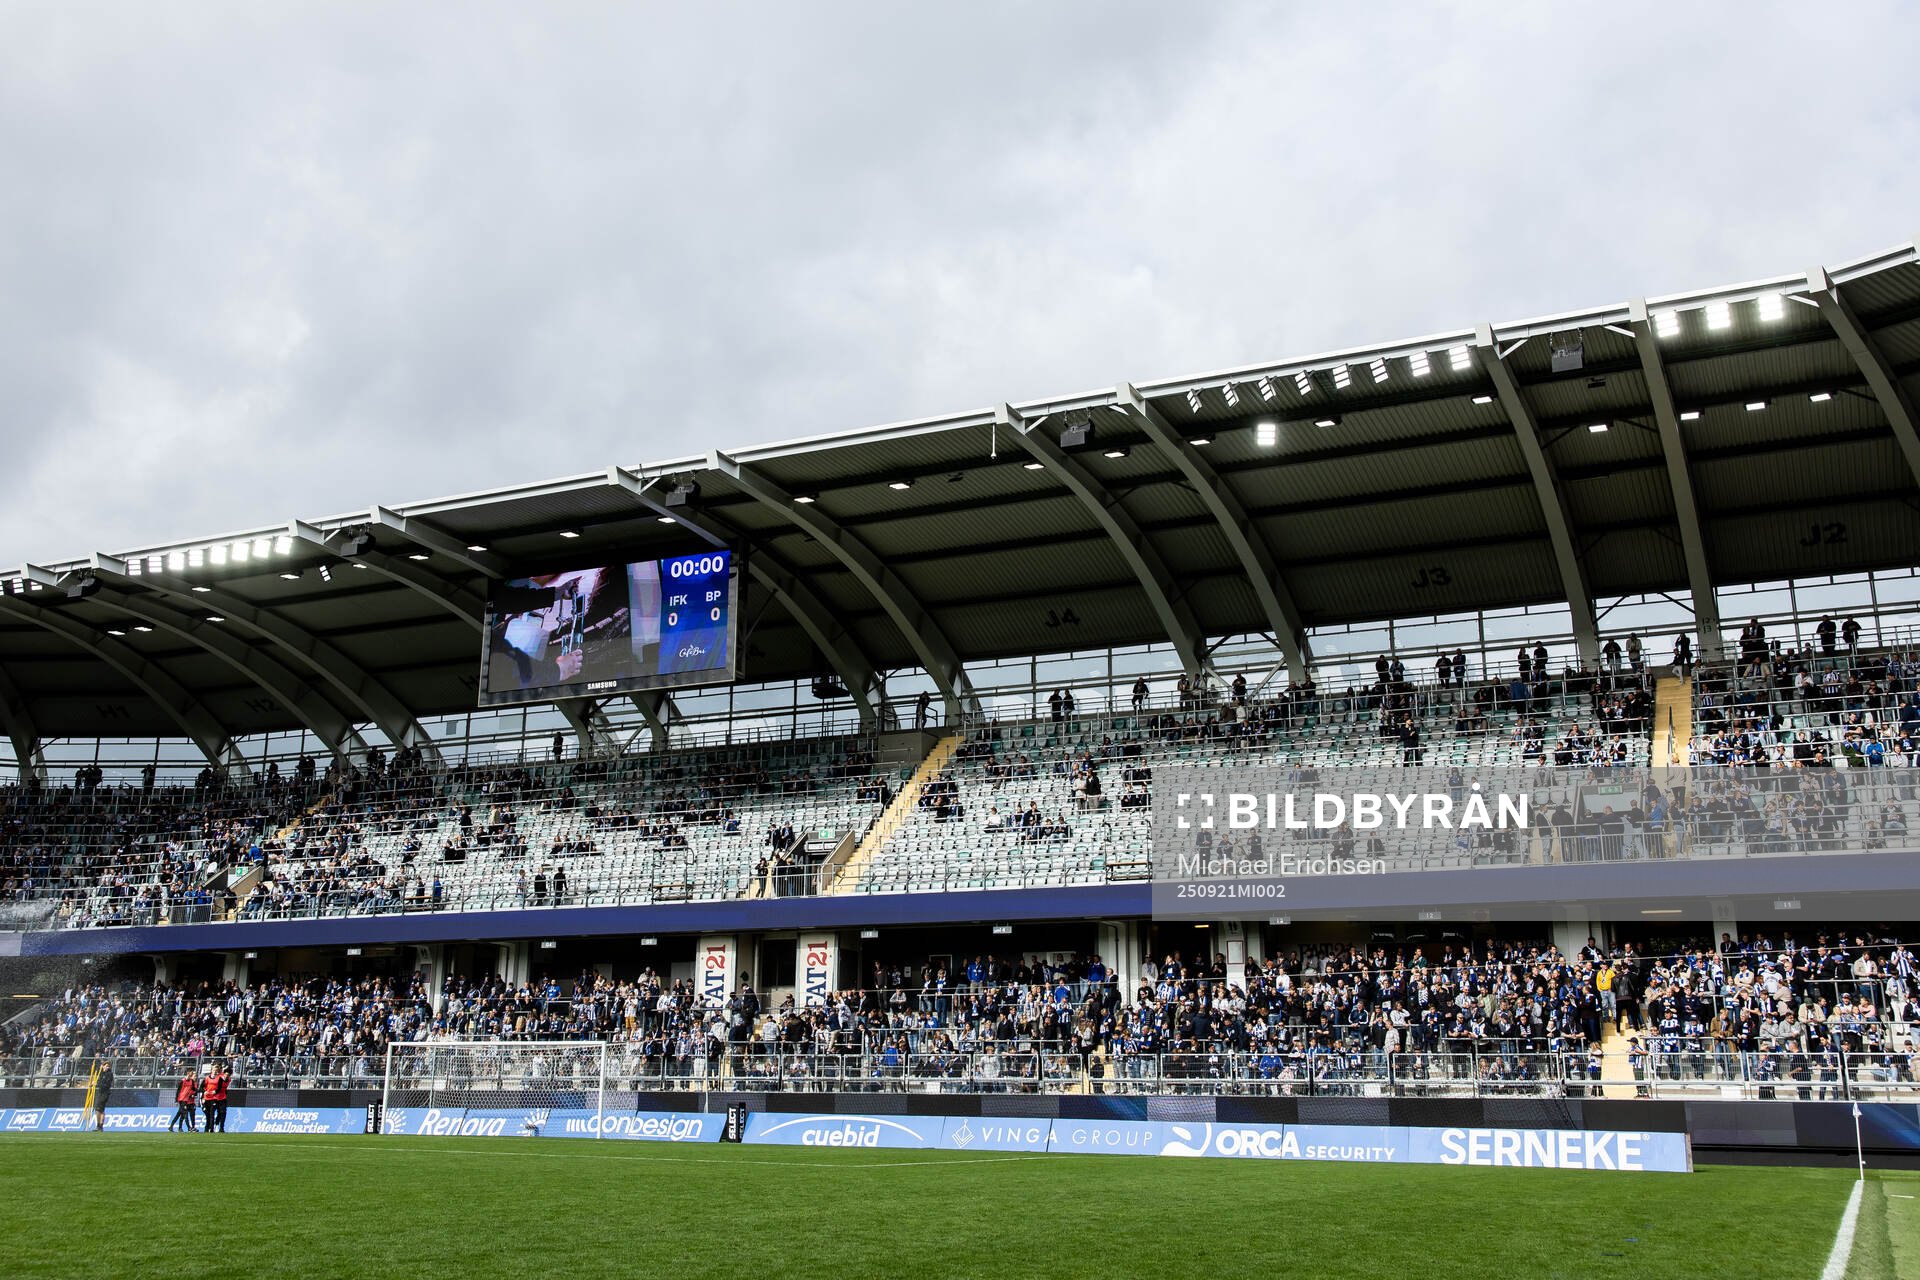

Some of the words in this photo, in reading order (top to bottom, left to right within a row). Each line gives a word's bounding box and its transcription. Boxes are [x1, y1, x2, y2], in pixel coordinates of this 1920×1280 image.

[671, 556, 724, 578] 00:00
[669, 594, 688, 606] IFK
[706, 590, 721, 602] BP
[668, 612, 678, 626] 0
[711, 607, 720, 621] 0
[587, 680, 617, 690] SAMSUNG
[14, 1112, 38, 1125] MCR
[55, 1113, 80, 1126] MCR
[263, 1108, 319, 1124] Göteborgs
[417, 1109, 506, 1136] Renova
[728, 1107, 736, 1140] SELECT
[802, 1123, 881, 1147] cuebid
[982, 1127, 1058, 1144] VINGA
[1072, 1129, 1153, 1147] GROUP
[1215, 1129, 1301, 1158] ORCA
[1306, 1146, 1396, 1160] SECURITY
[1440, 1128, 1644, 1170] SERNEKE
